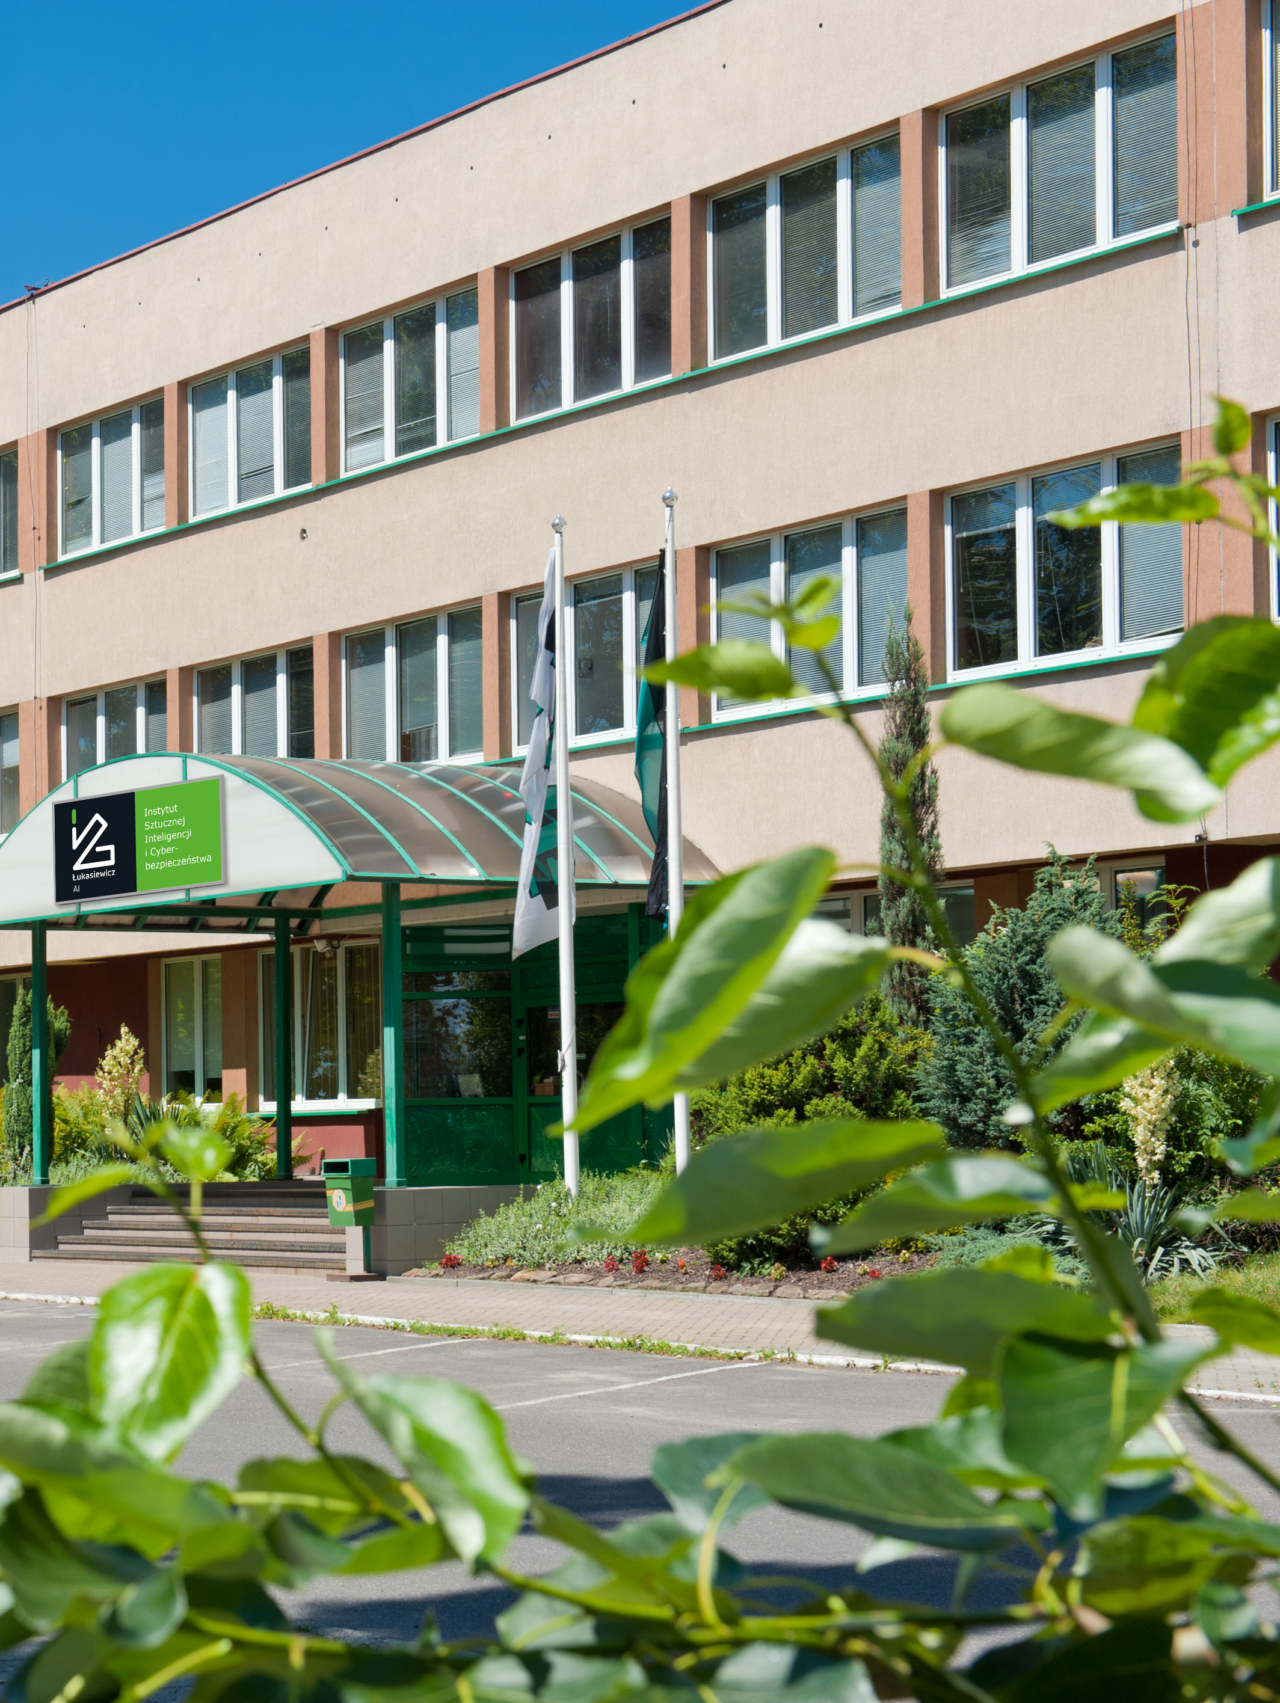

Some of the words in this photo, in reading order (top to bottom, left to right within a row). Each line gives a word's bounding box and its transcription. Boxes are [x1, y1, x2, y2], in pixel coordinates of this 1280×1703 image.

[144, 804, 178, 817] Instytut
[144, 815, 186, 830] Sztucznej
[145, 829, 192, 843] Inteligencji
[145, 848, 148, 857] i
[150, 846, 179, 857] Cyber-
[145, 854, 212, 871] bezpieczeństwa
[72, 869, 116, 881] Łukasiewicz
